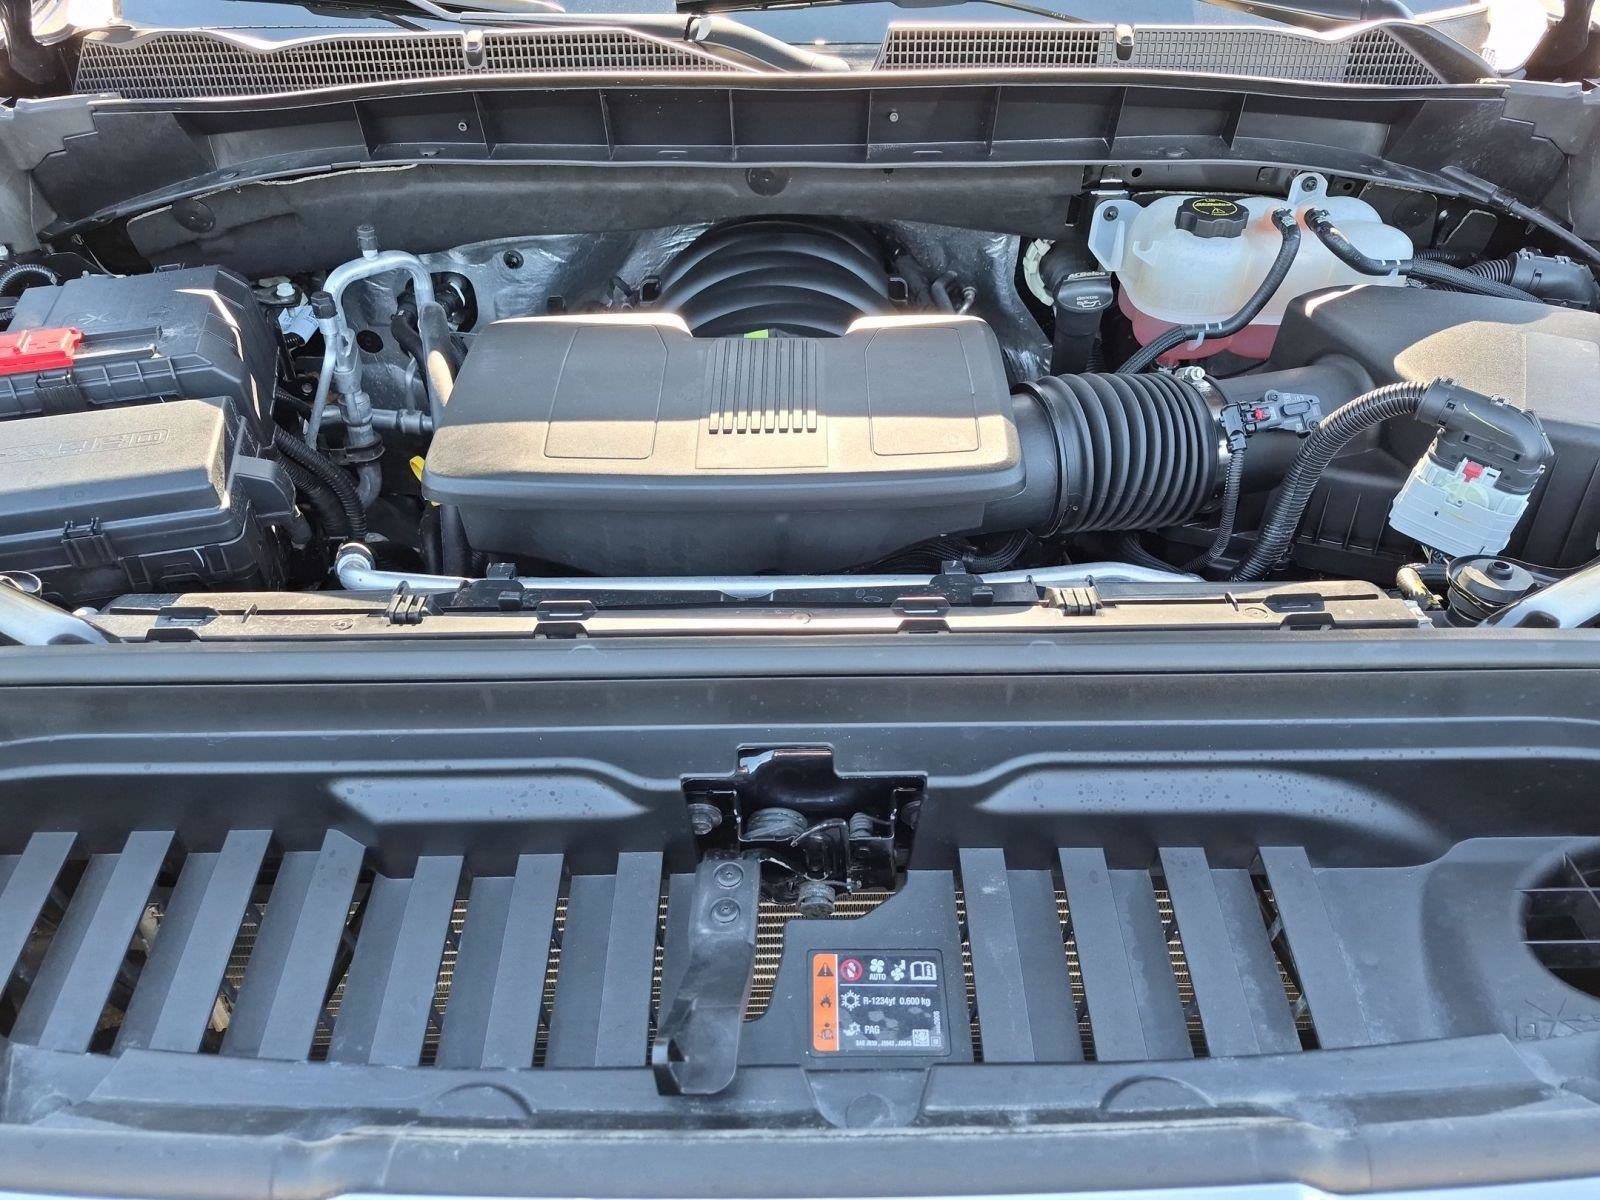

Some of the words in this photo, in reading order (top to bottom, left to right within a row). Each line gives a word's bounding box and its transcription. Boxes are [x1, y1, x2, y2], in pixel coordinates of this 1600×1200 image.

[869, 973, 887, 981] AUTO
[863, 996, 896, 1006] R-1234yf
[899, 996, 920, 1006] 0.600
[921, 996, 931, 1007] kg
[864, 1025, 880, 1035] PAG
